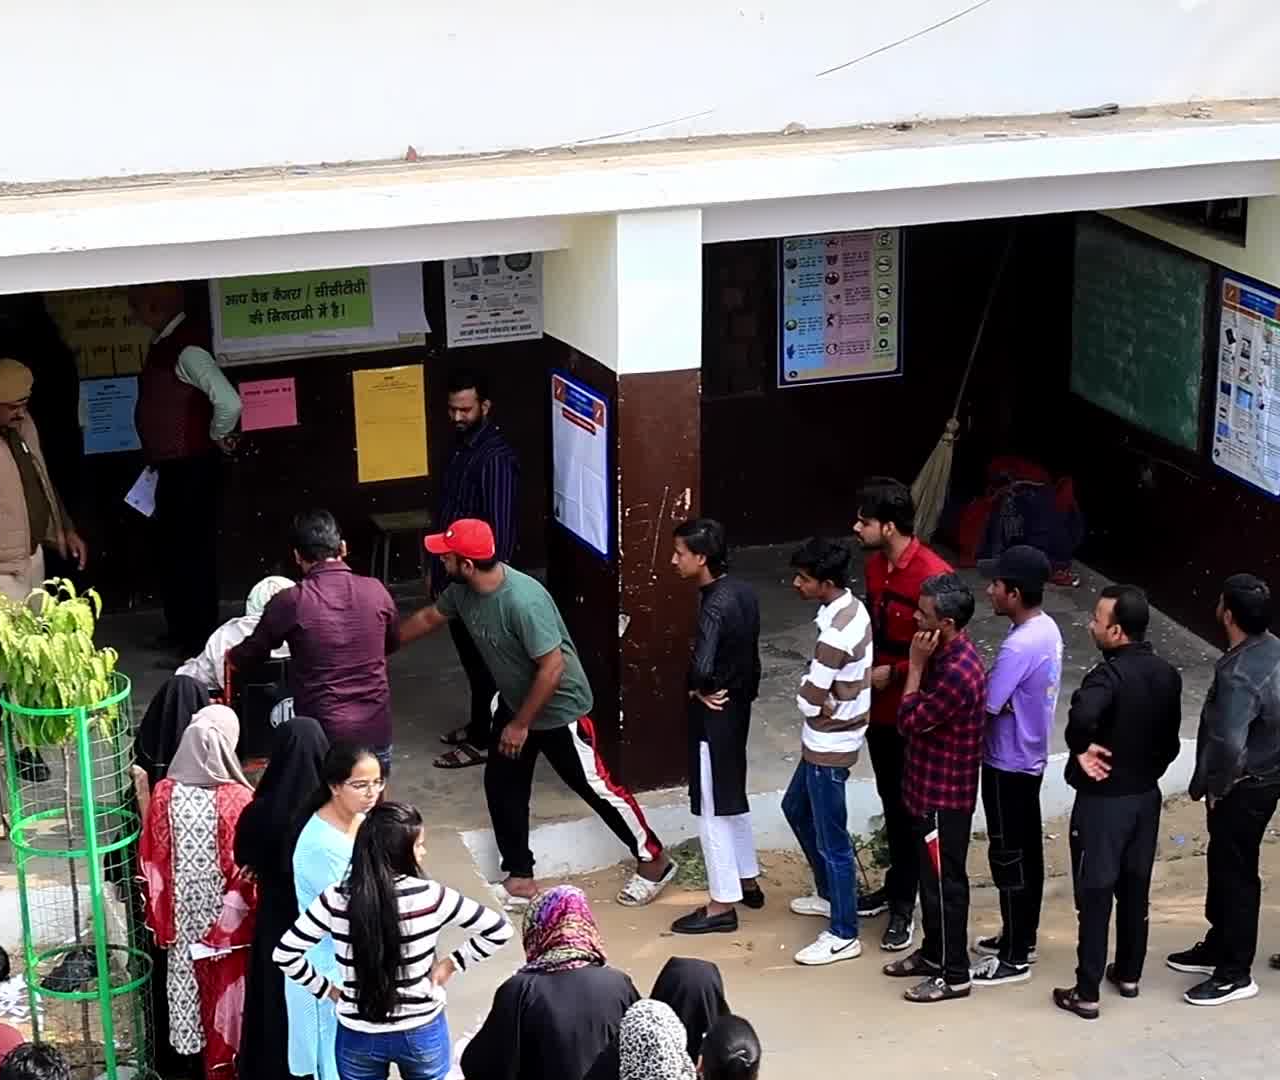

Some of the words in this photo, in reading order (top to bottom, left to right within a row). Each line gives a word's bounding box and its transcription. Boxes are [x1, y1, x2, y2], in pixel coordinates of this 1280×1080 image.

[224, 294, 249, 306] आप
[314, 279, 368, 298] सीसीटीवी
[267, 304, 314, 323] निगरानी
[317, 302, 328, 319] में
